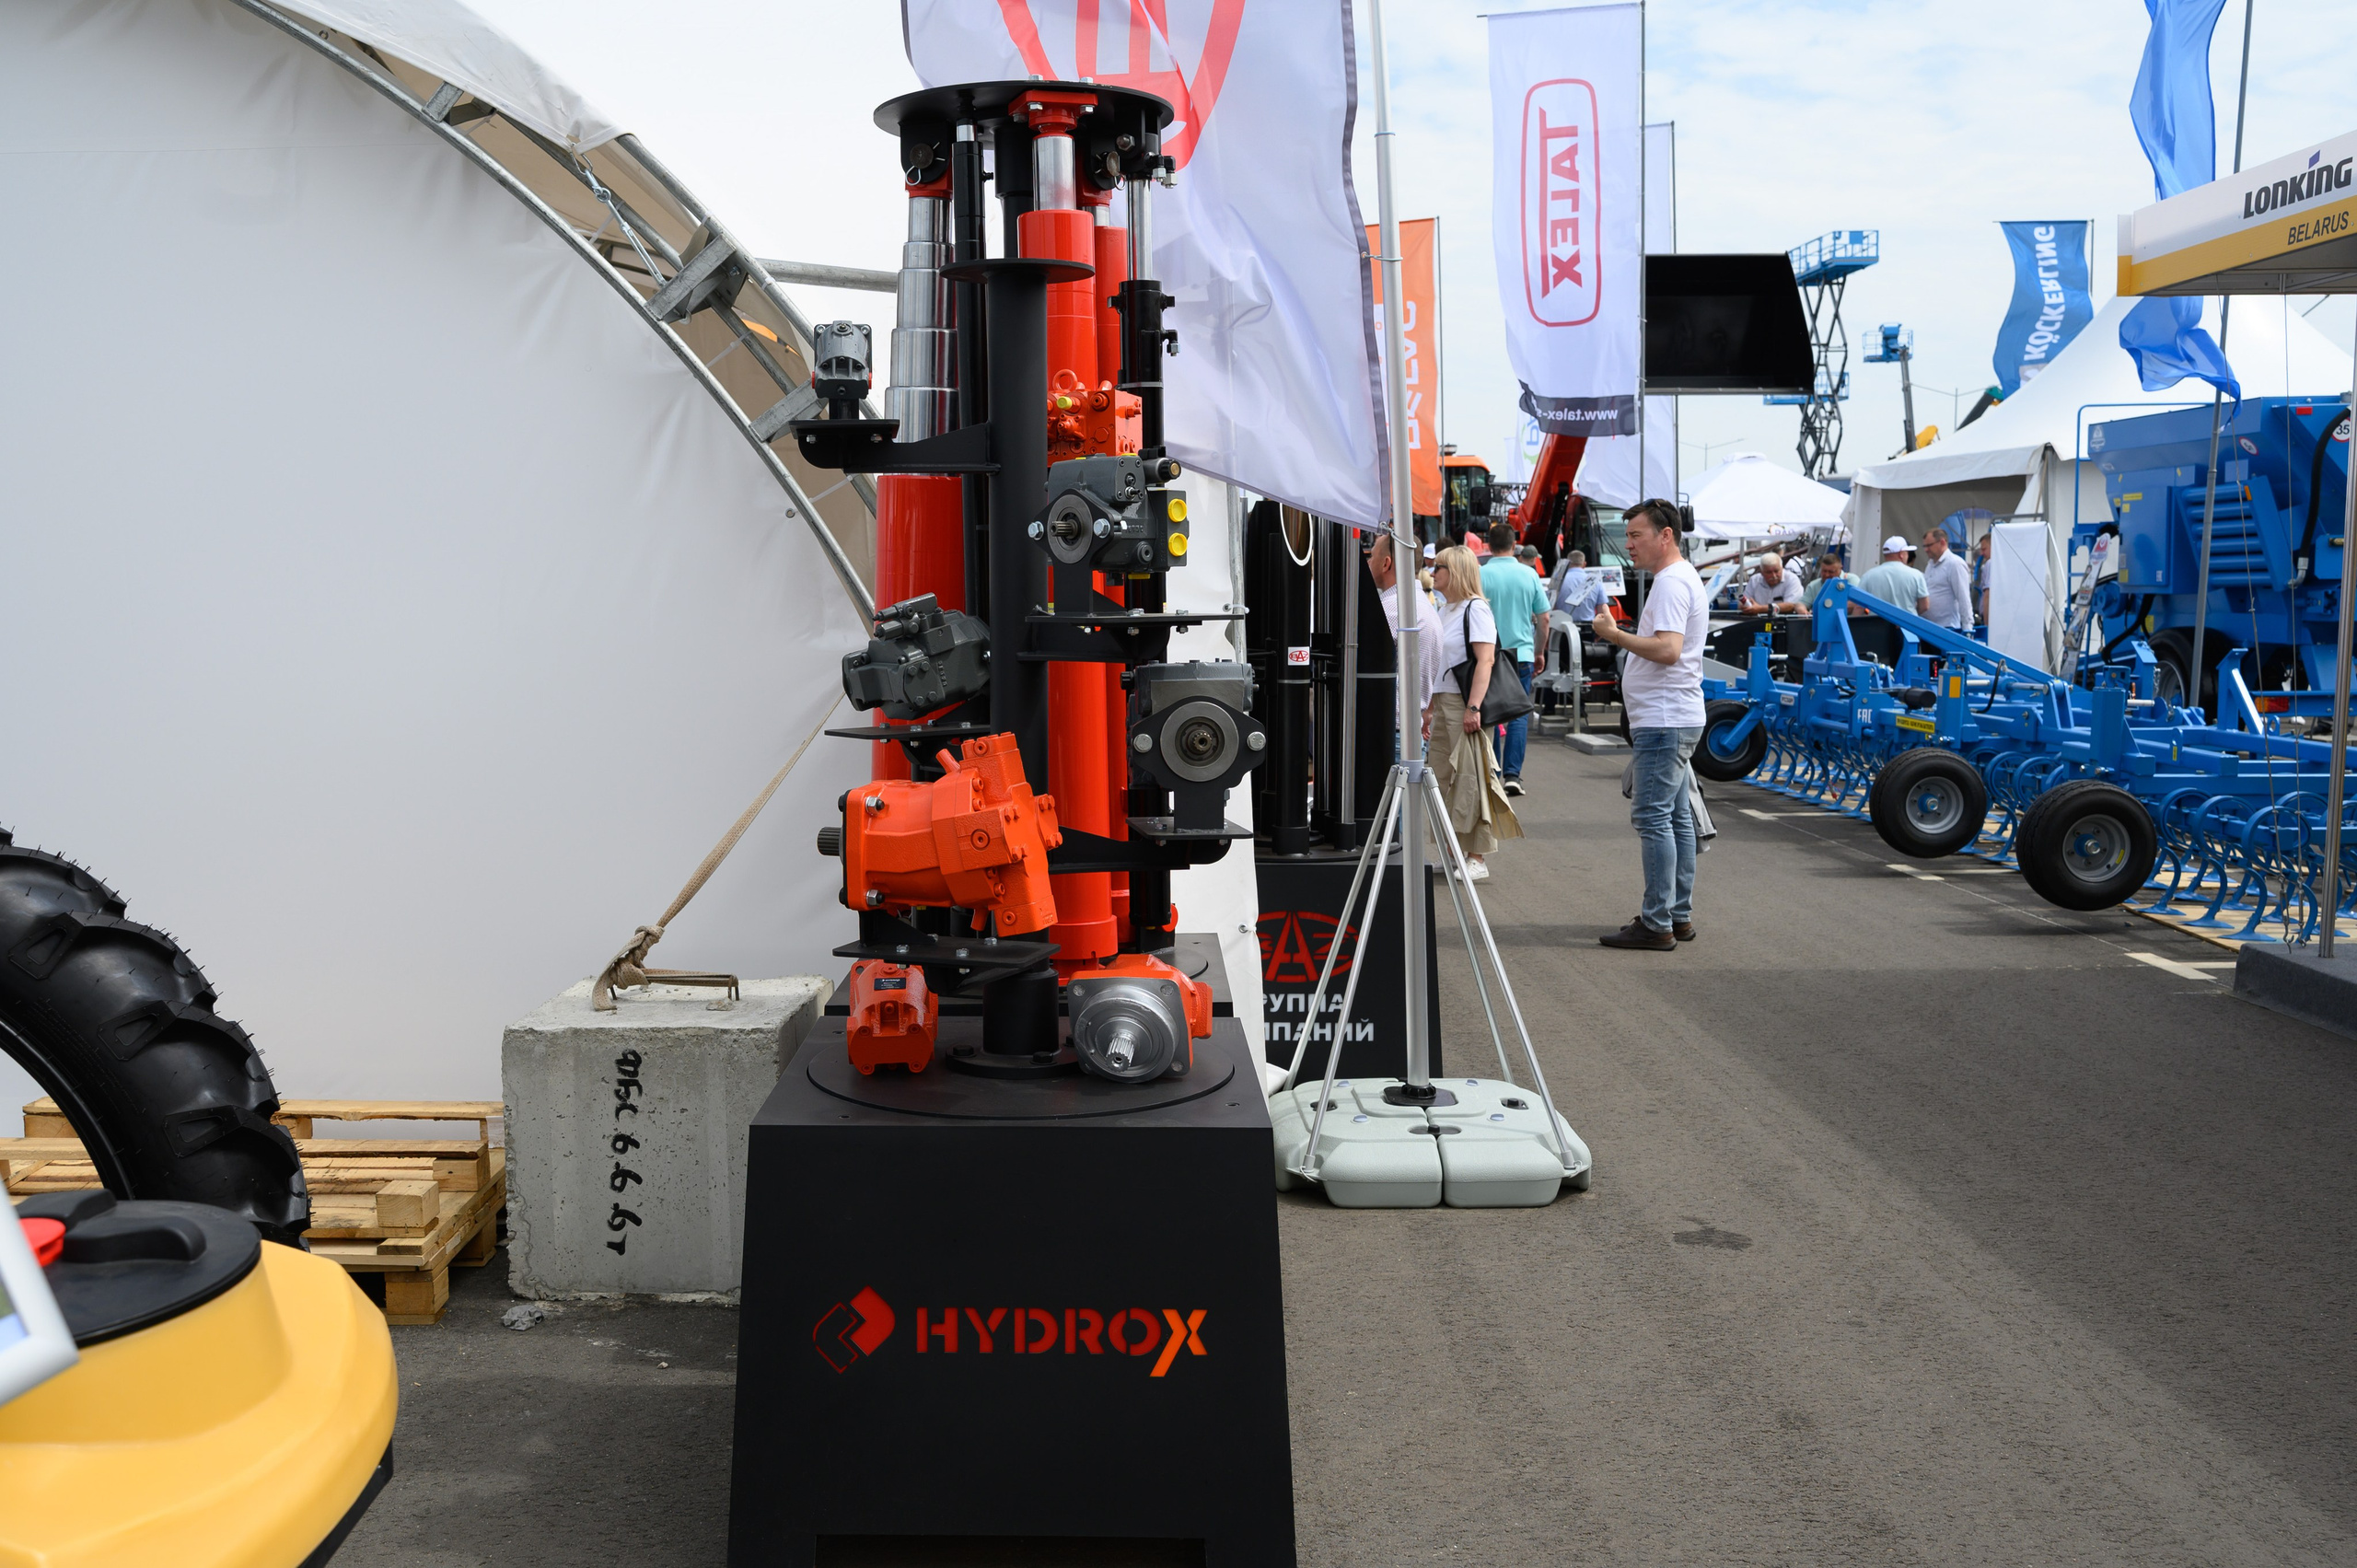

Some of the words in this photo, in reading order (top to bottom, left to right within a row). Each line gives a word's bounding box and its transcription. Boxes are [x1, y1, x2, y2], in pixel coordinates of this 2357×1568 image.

[2287, 211, 2350, 246] BELARUS
[2336, 424, 2350, 435] 35
[916, 1307, 1208, 1377] HYDROX
